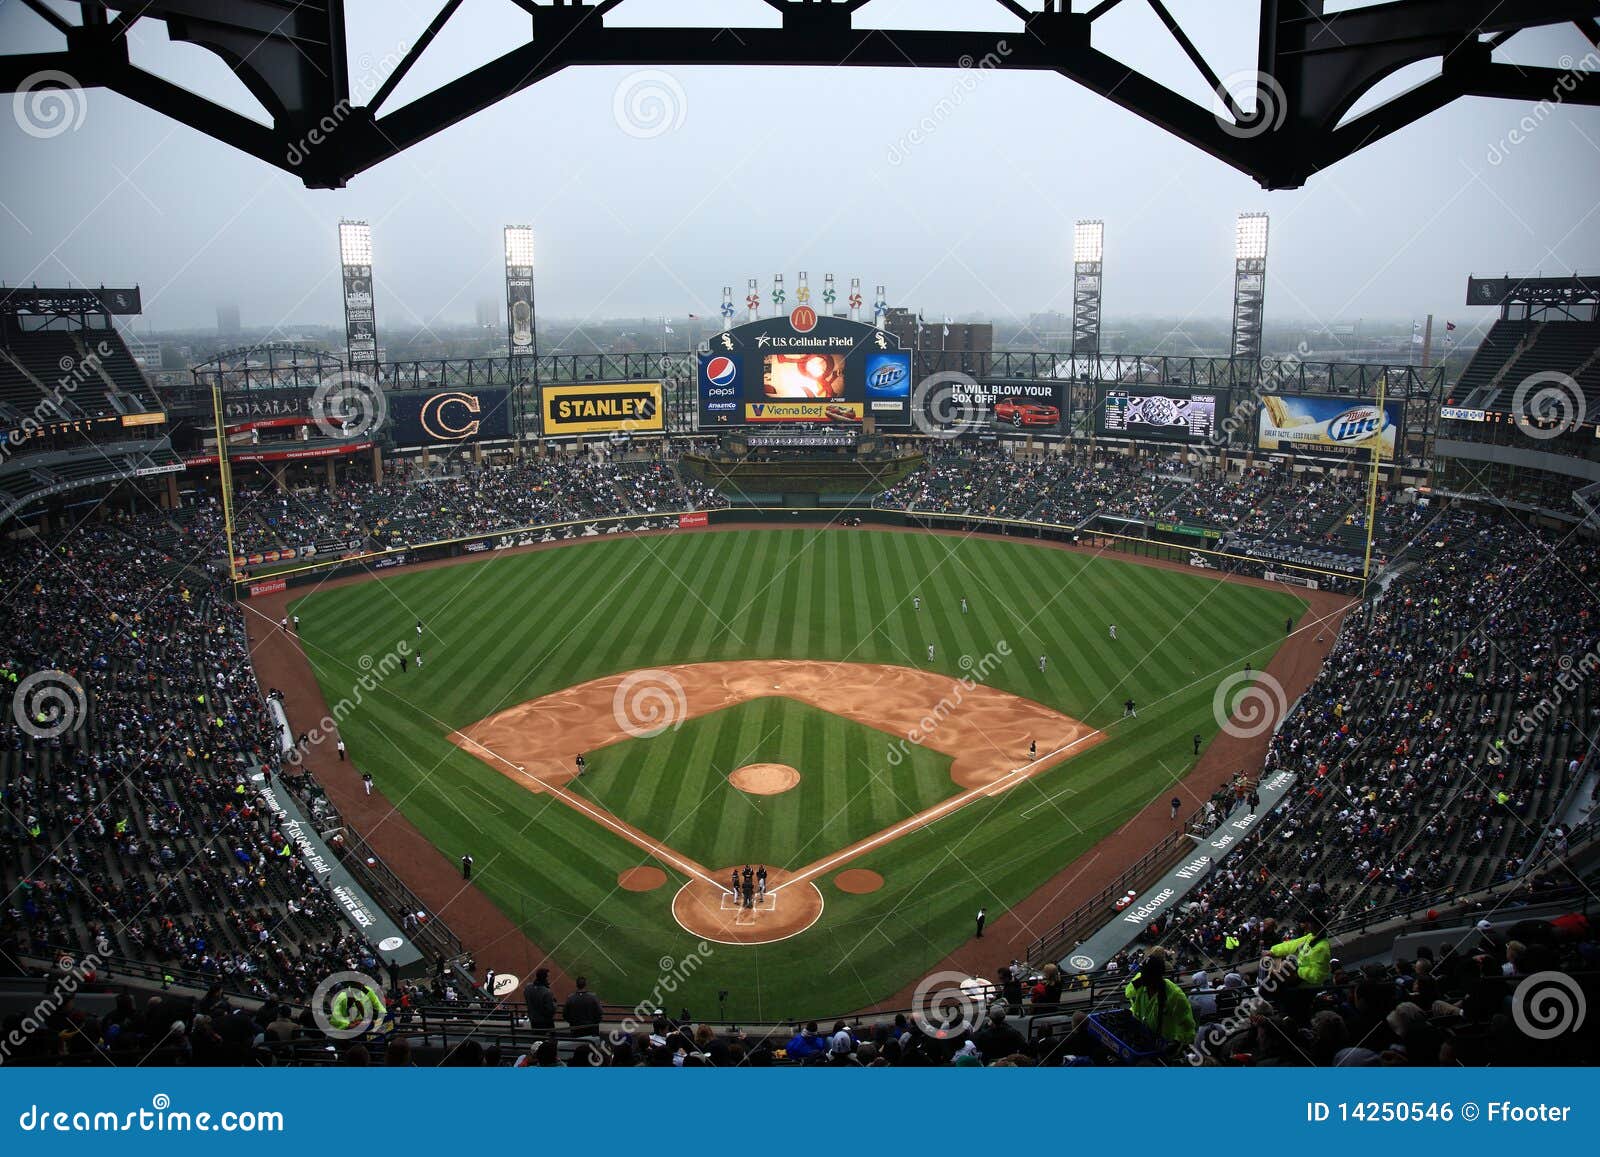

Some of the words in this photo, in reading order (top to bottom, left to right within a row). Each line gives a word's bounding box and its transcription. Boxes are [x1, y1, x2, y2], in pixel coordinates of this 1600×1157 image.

[789, 336, 827, 346] Cellular
[829, 337, 853, 346] Field
[708, 387, 735, 397] pepsi
[952, 384, 962, 393] IT
[964, 385, 990, 394] WILL
[992, 385, 1022, 395] BLOW
[1024, 386, 1052, 397] YOUR
[952, 394, 972, 403] SOX
[974, 394, 997, 404] OFF!
[559, 398, 647, 418] STANLEY
[767, 405, 799, 416] Vienna
[801, 406, 823, 416] Beef
[1346, 410, 1374, 421] Miller
[1336, 417, 1382, 441] Lite
[309, 855, 332, 874] Field
[1124, 887, 1175, 925] Welcome
[1176, 855, 1211, 880] White
[1211, 833, 1235, 849] Sox
[1232, 812, 1257, 830] Fans
[333, 886, 358, 911] WHITE
[352, 908, 373, 928] SOX
